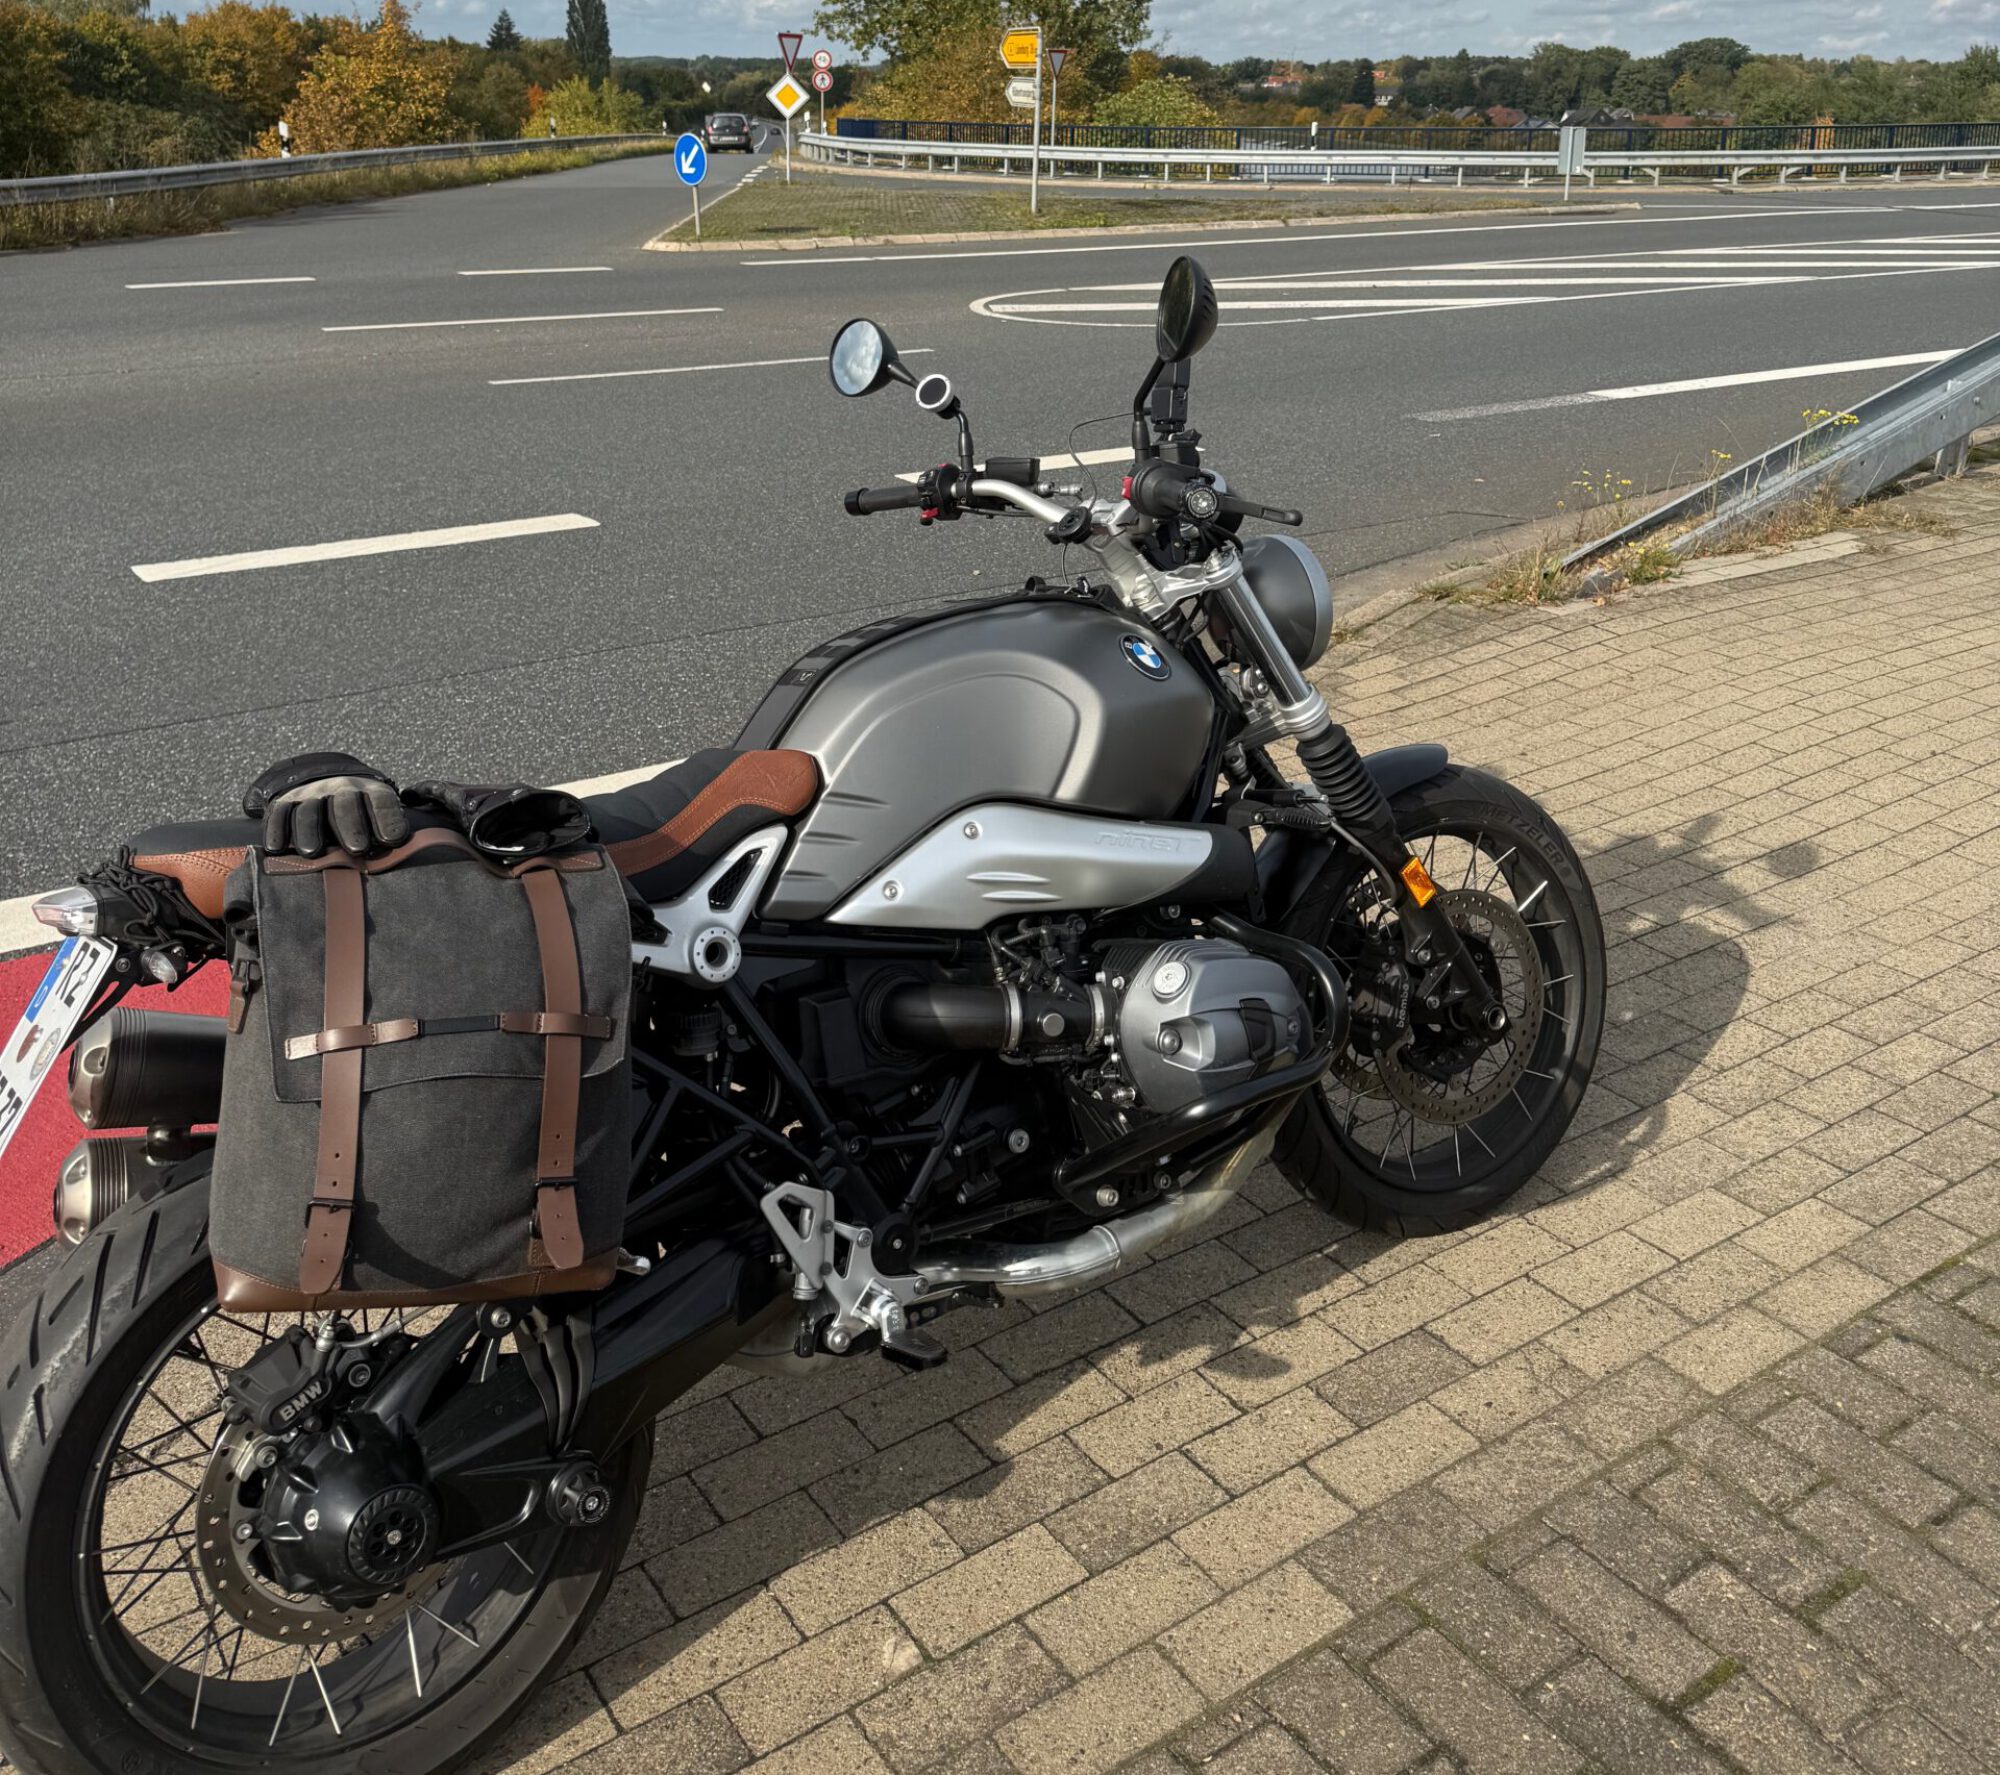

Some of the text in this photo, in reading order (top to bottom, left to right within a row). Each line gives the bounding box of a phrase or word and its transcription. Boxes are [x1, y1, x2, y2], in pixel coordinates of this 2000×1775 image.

[1481, 804, 1564, 865] METZELER
[55, 941, 101, 1008] RZ
[1396, 983, 1410, 1028] brembo
[280, 1381, 322, 1421] BMW
